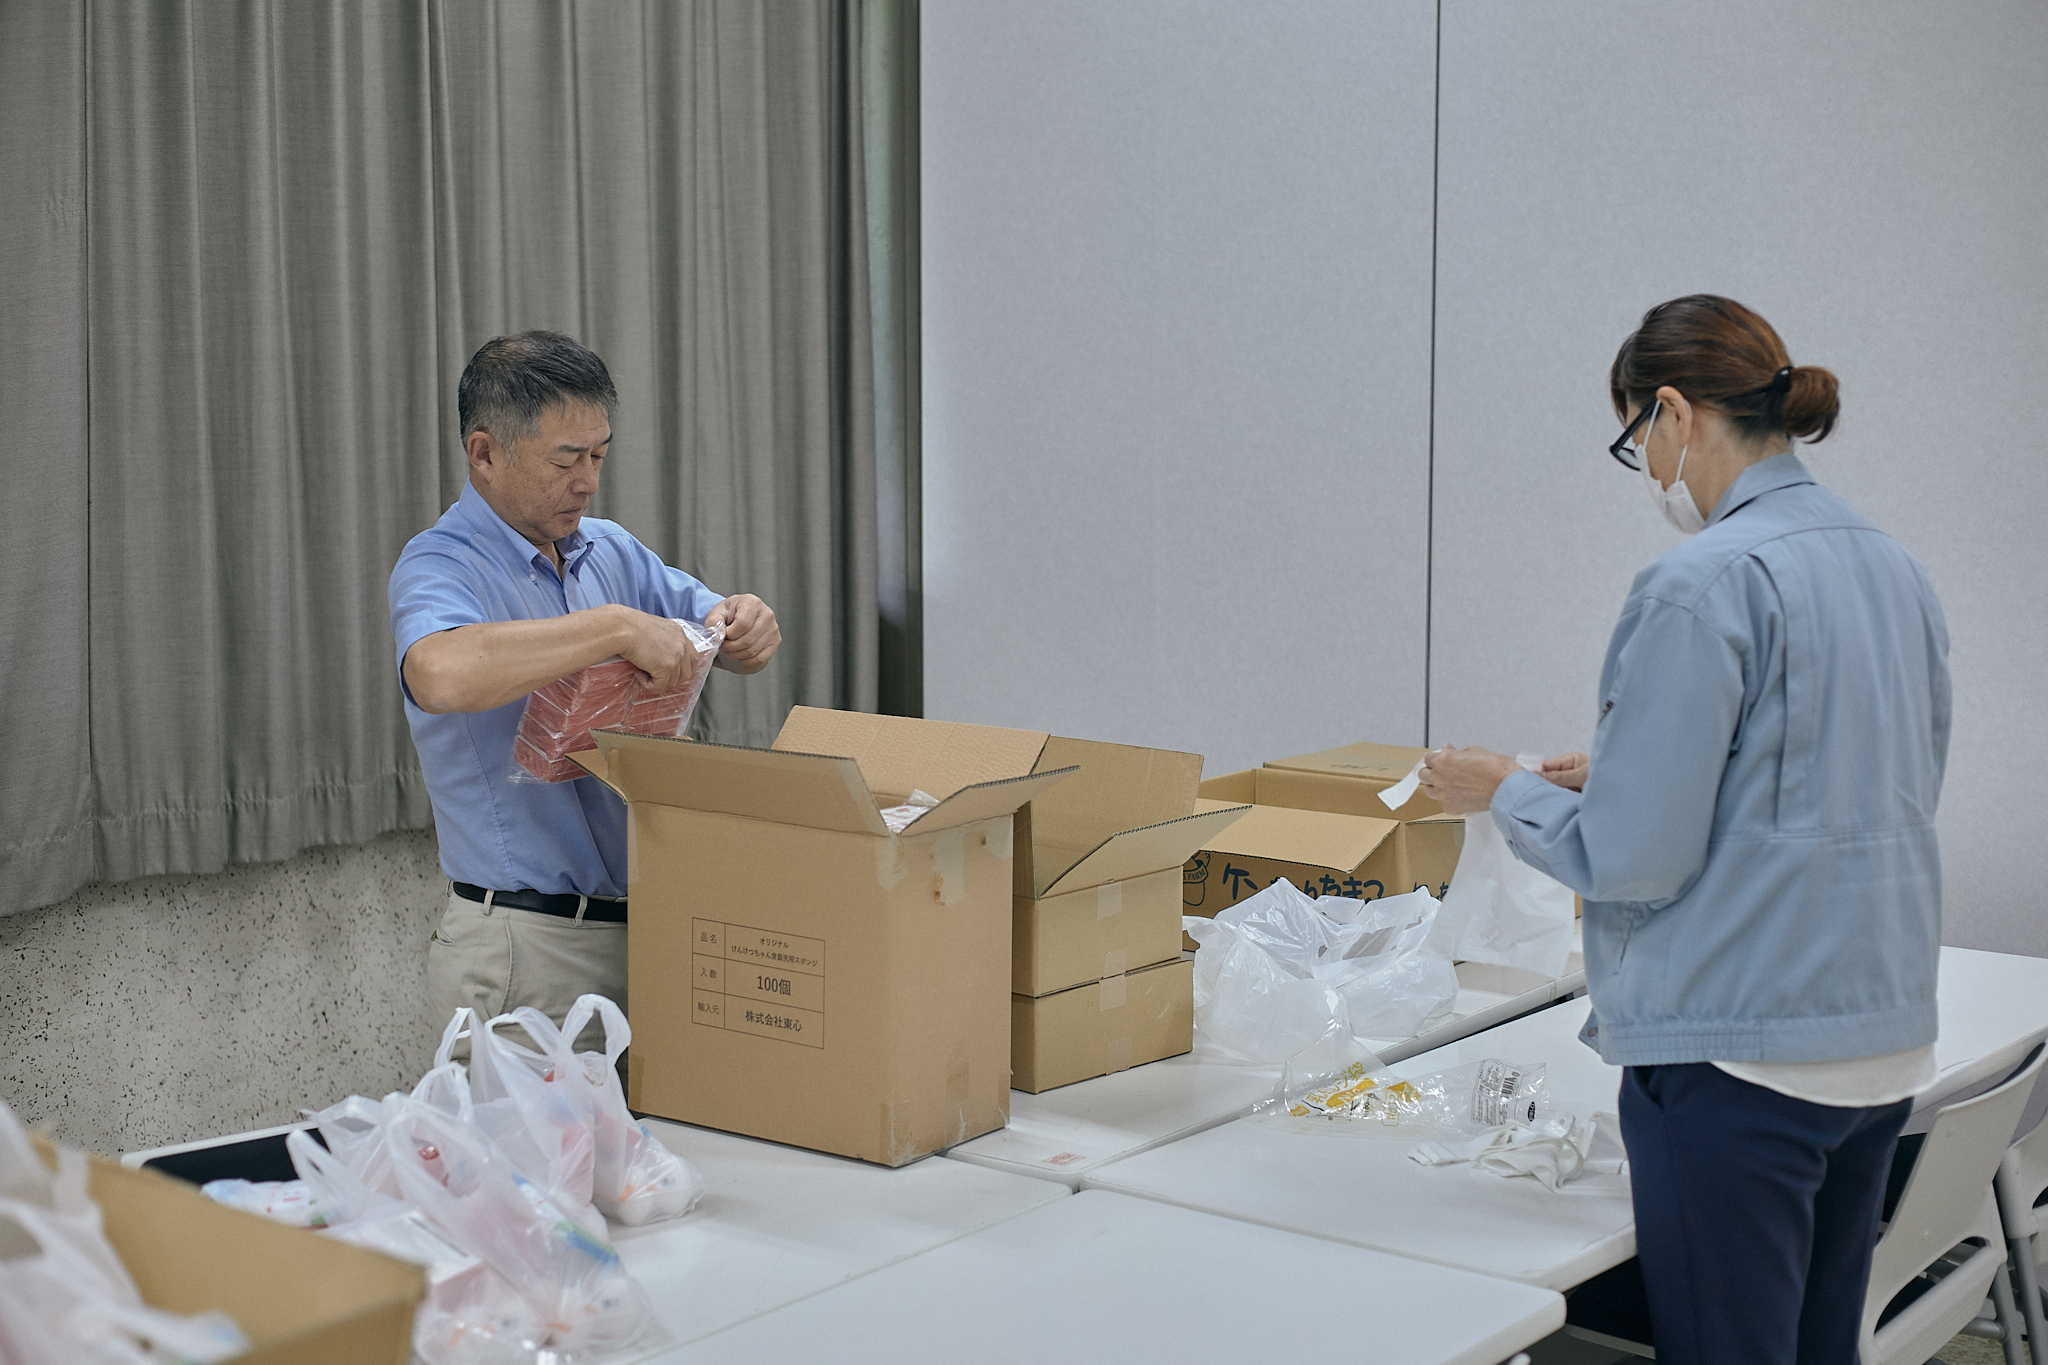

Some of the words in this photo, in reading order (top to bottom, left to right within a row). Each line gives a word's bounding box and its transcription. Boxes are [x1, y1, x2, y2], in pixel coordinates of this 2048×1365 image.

[1188, 868, 1206, 881] FARM
[700, 932, 717, 944] 品名
[759, 937, 790, 949] オリジナル
[700, 967, 717, 979] 入数
[757, 975, 791, 996] 100個
[697, 1002, 720, 1015] 輸入元
[745, 1009, 803, 1032] 株式会社東心
